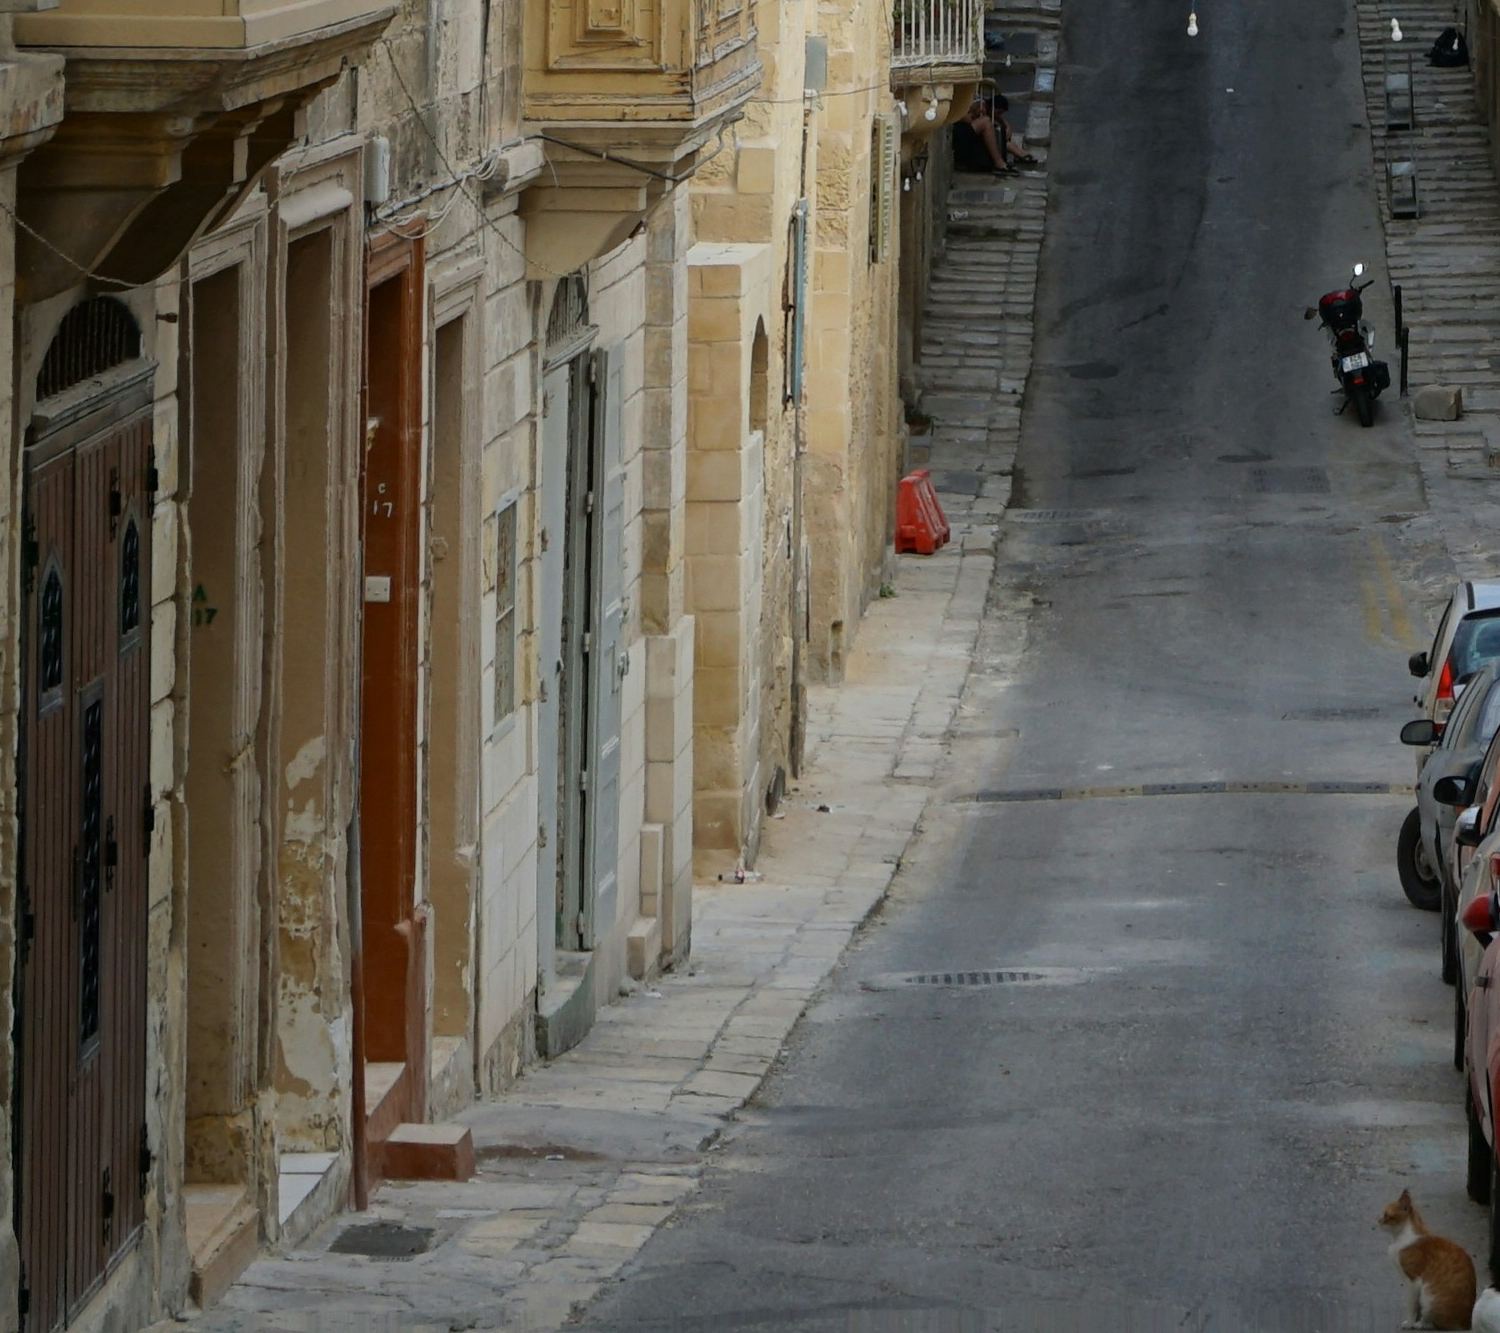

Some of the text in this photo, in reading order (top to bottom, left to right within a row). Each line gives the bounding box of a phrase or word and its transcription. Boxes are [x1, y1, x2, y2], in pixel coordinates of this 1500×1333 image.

[373, 499, 393, 518] 17
[192, 582, 207, 603] A
[195, 607, 219, 627] 17
